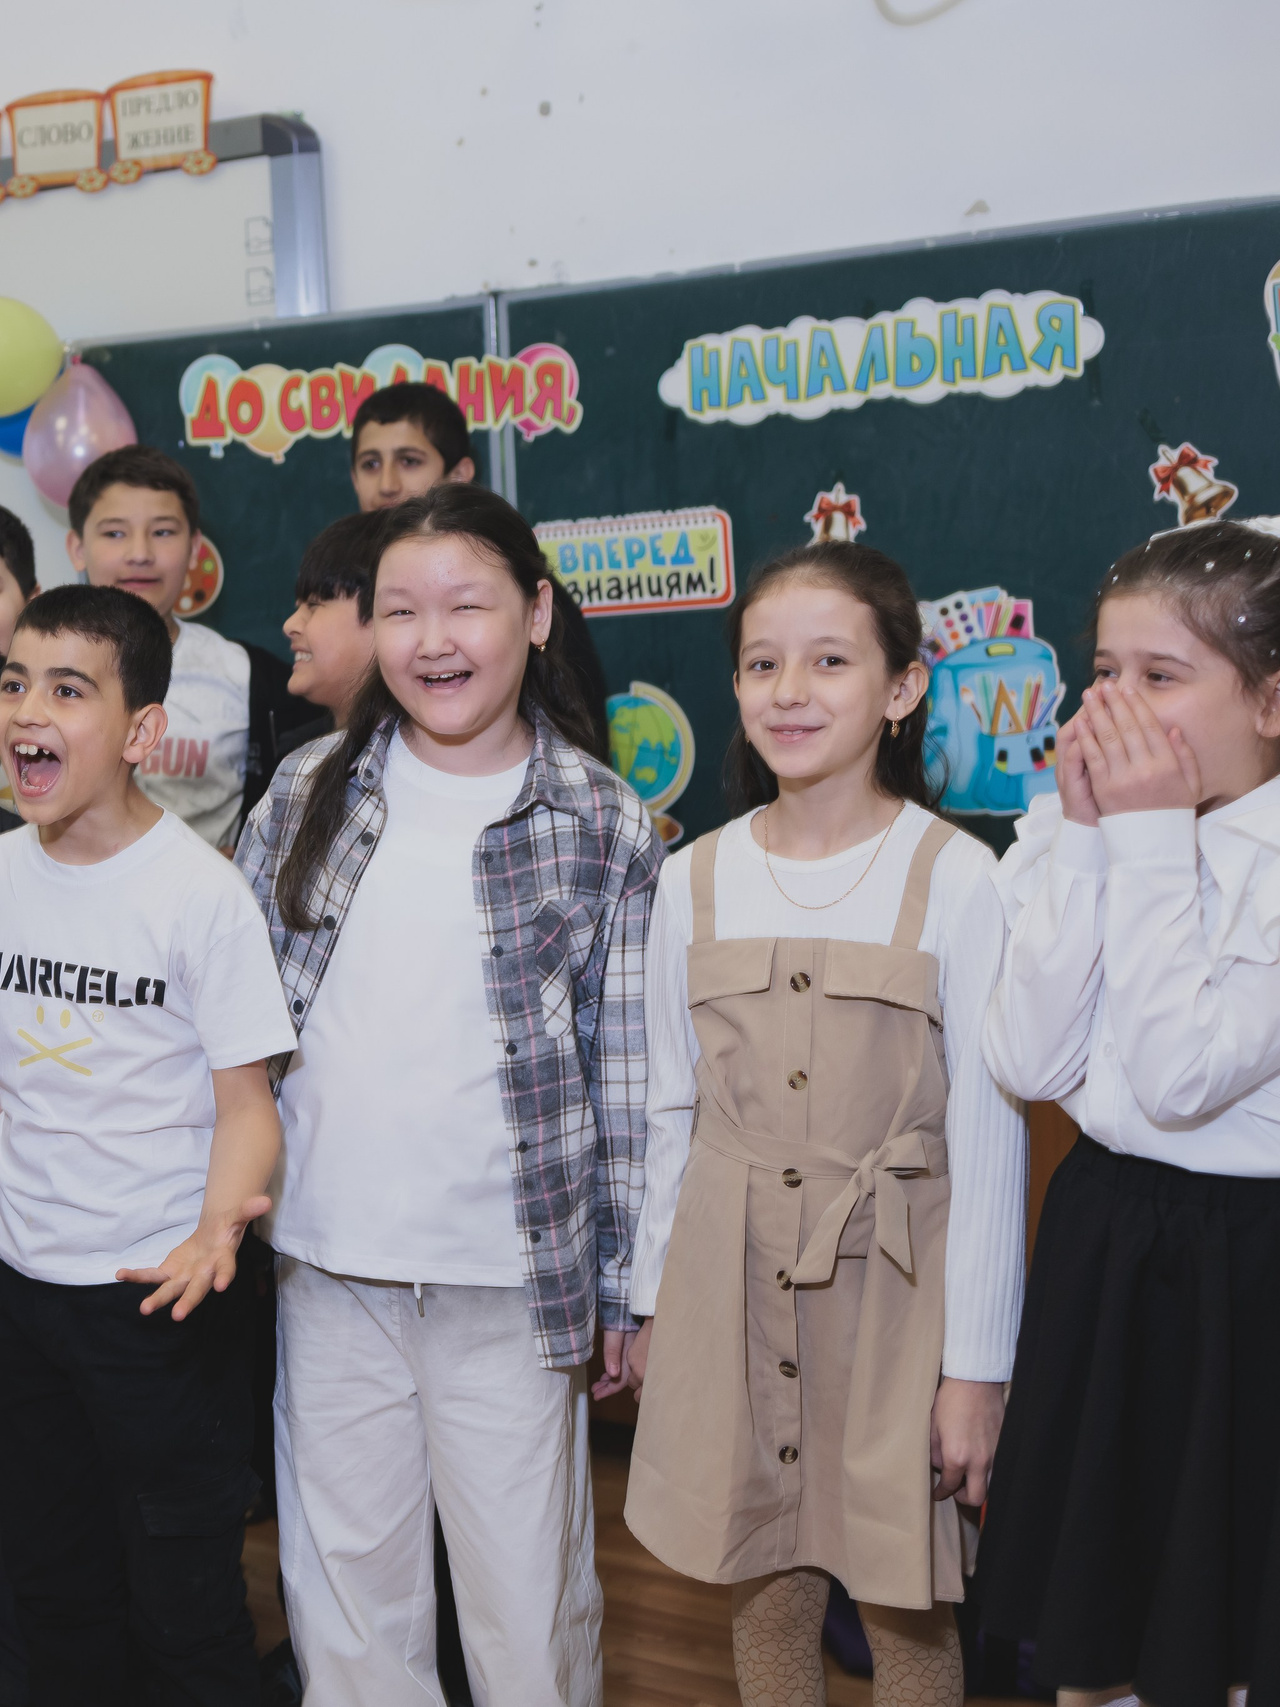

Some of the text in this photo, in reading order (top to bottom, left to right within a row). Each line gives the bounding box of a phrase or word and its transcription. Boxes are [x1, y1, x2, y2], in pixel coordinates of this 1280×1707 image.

[122, 88, 199, 117] ПРЕДЛО
[18, 120, 93, 148] СЛОВО
[127, 123, 195, 151] ЖЕНИЕ
[690, 302, 1077, 412] НАЧАЛЬНАЯ
[191, 376, 263, 438] ДО
[558, 530, 695, 574] ВПЕРЕД
